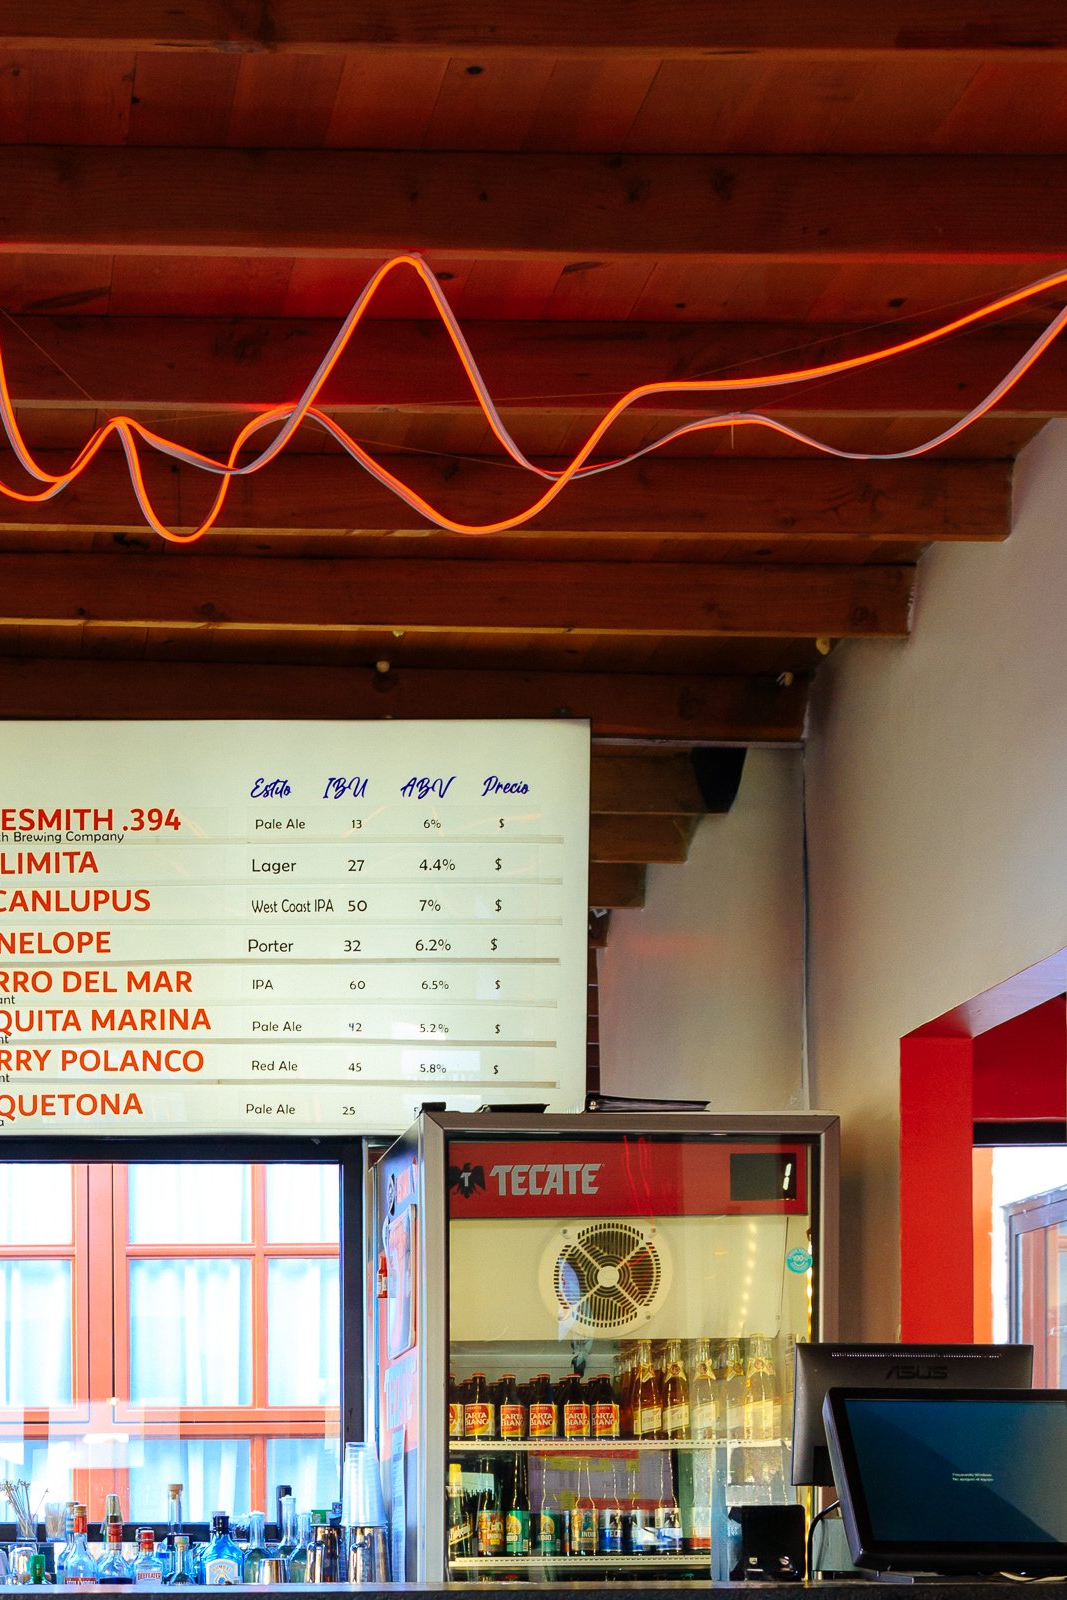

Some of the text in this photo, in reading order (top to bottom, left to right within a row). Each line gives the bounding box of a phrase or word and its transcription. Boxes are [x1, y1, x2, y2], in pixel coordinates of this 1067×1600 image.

[250, 777, 292, 799] Estilo
[322, 777, 369, 800] IBU
[400, 775, 456, 800] ABV
[482, 776, 530, 799] Precio
[123, 808, 180, 831] .394
[255, 818, 306, 830] Pale Ale
[351, 819, 363, 829] 13
[423, 819, 442, 829] 6%
[12, 831, 62, 845] Brewing
[66, 832, 126, 845] Company
[252, 858, 297, 875] Lager
[347, 859, 365, 872] 27
[419, 858, 456, 871] 4.4%
[494, 857, 502, 872] $
[251, 898, 334, 914] West Coast IPA
[347, 899, 368, 912] 50
[419, 899, 441, 912] 7%
[494, 898, 502, 913] $
[248, 938, 294, 953] Porter
[343, 939, 362, 952] 32
[415, 938, 452, 952] 6.2%
[490, 937, 498, 952] $
[63, 971, 116, 992] DEL
[127, 971, 192, 992] MAR
[252, 979, 274, 990] IPA
[349, 980, 366, 990] 60
[421, 980, 449, 990] 6.5%
[92, 1009, 210, 1030] MARINA
[252, 1021, 302, 1032] Pale Ale
[419, 1023, 450, 1034] 5.2%
[62, 1050, 204, 1072] POLANCO
[251, 1060, 298, 1072] Red Ale
[348, 1062, 362, 1072] 45
[420, 1063, 447, 1074] 5.8%
[246, 1103, 296, 1115] Pale Ale
[342, 1106, 356, 1116] 25
[490, 1163, 603, 1197] TECATE
[885, 1365, 949, 1380] ASUS
[137, 1572, 162, 1581] BEEFEATER
